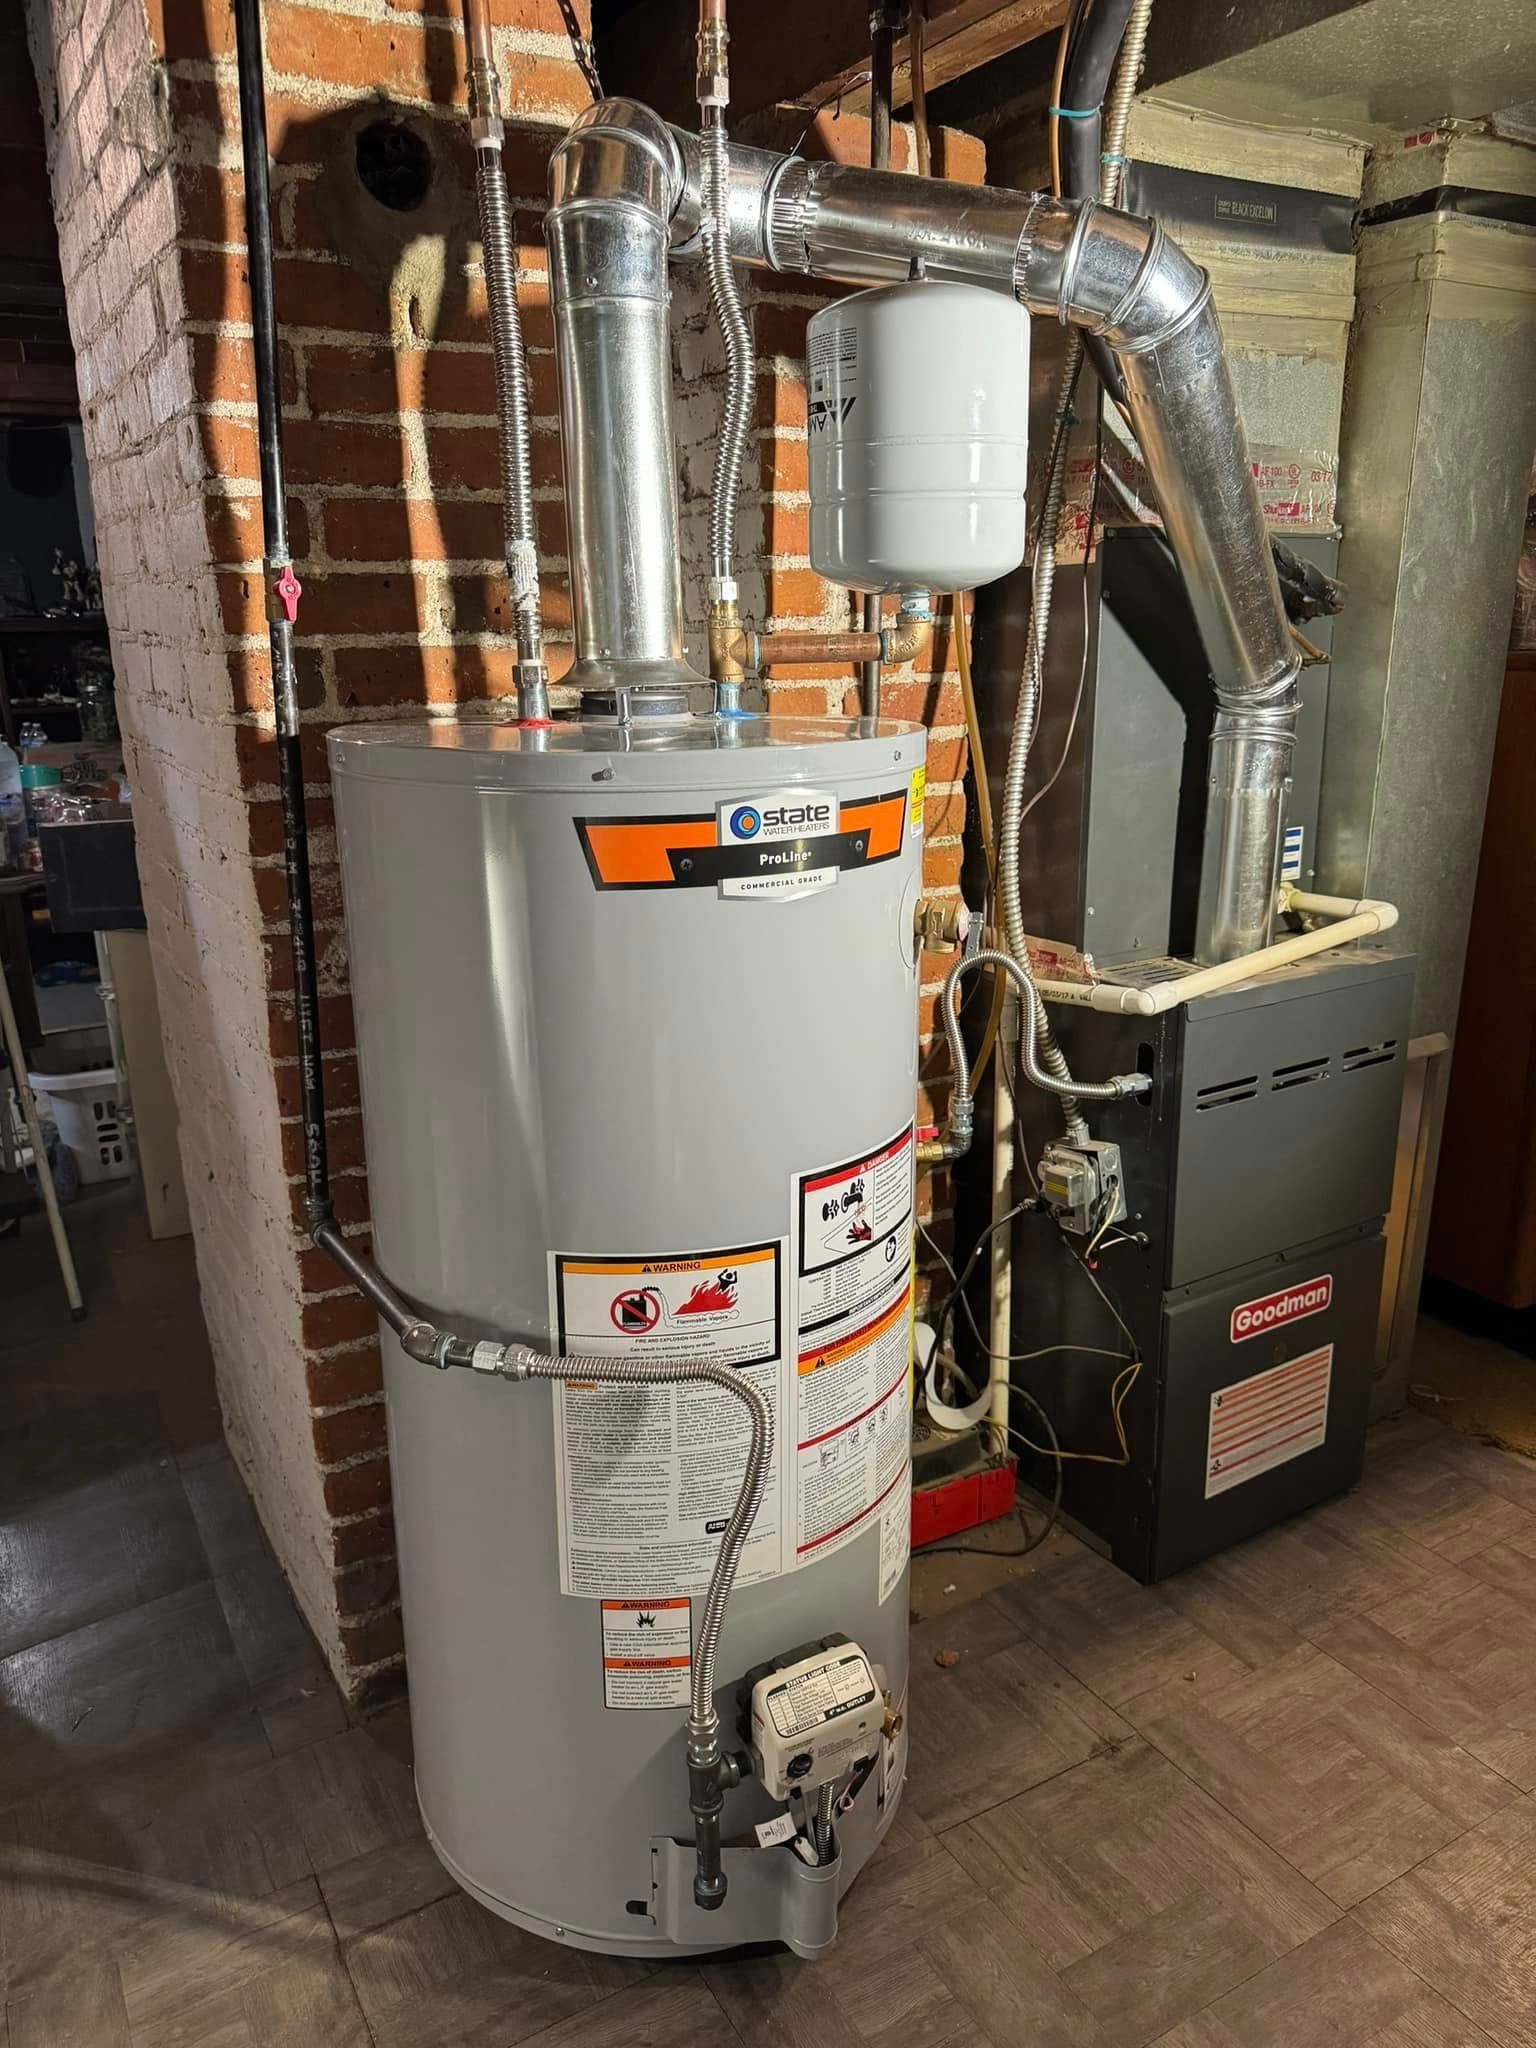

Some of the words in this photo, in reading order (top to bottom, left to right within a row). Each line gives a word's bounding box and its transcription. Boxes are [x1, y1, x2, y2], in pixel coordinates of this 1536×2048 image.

[1232, 201, 1249, 216] BLACK
[1250, 204, 1273, 221] EXCELON
[763, 805, 830, 826] state
[763, 826, 793, 836] WATER
[794, 822, 830, 833] HEATERS
[740, 880, 794, 890] COMMERCIAL
[798, 875, 823, 884] GRADE
[653, 1261, 701, 1272] WARNING
[1236, 1286, 1327, 1332] Goodman
[629, 1601, 670, 1609] WARNING
[786, 1675, 808, 1690] STATUS
